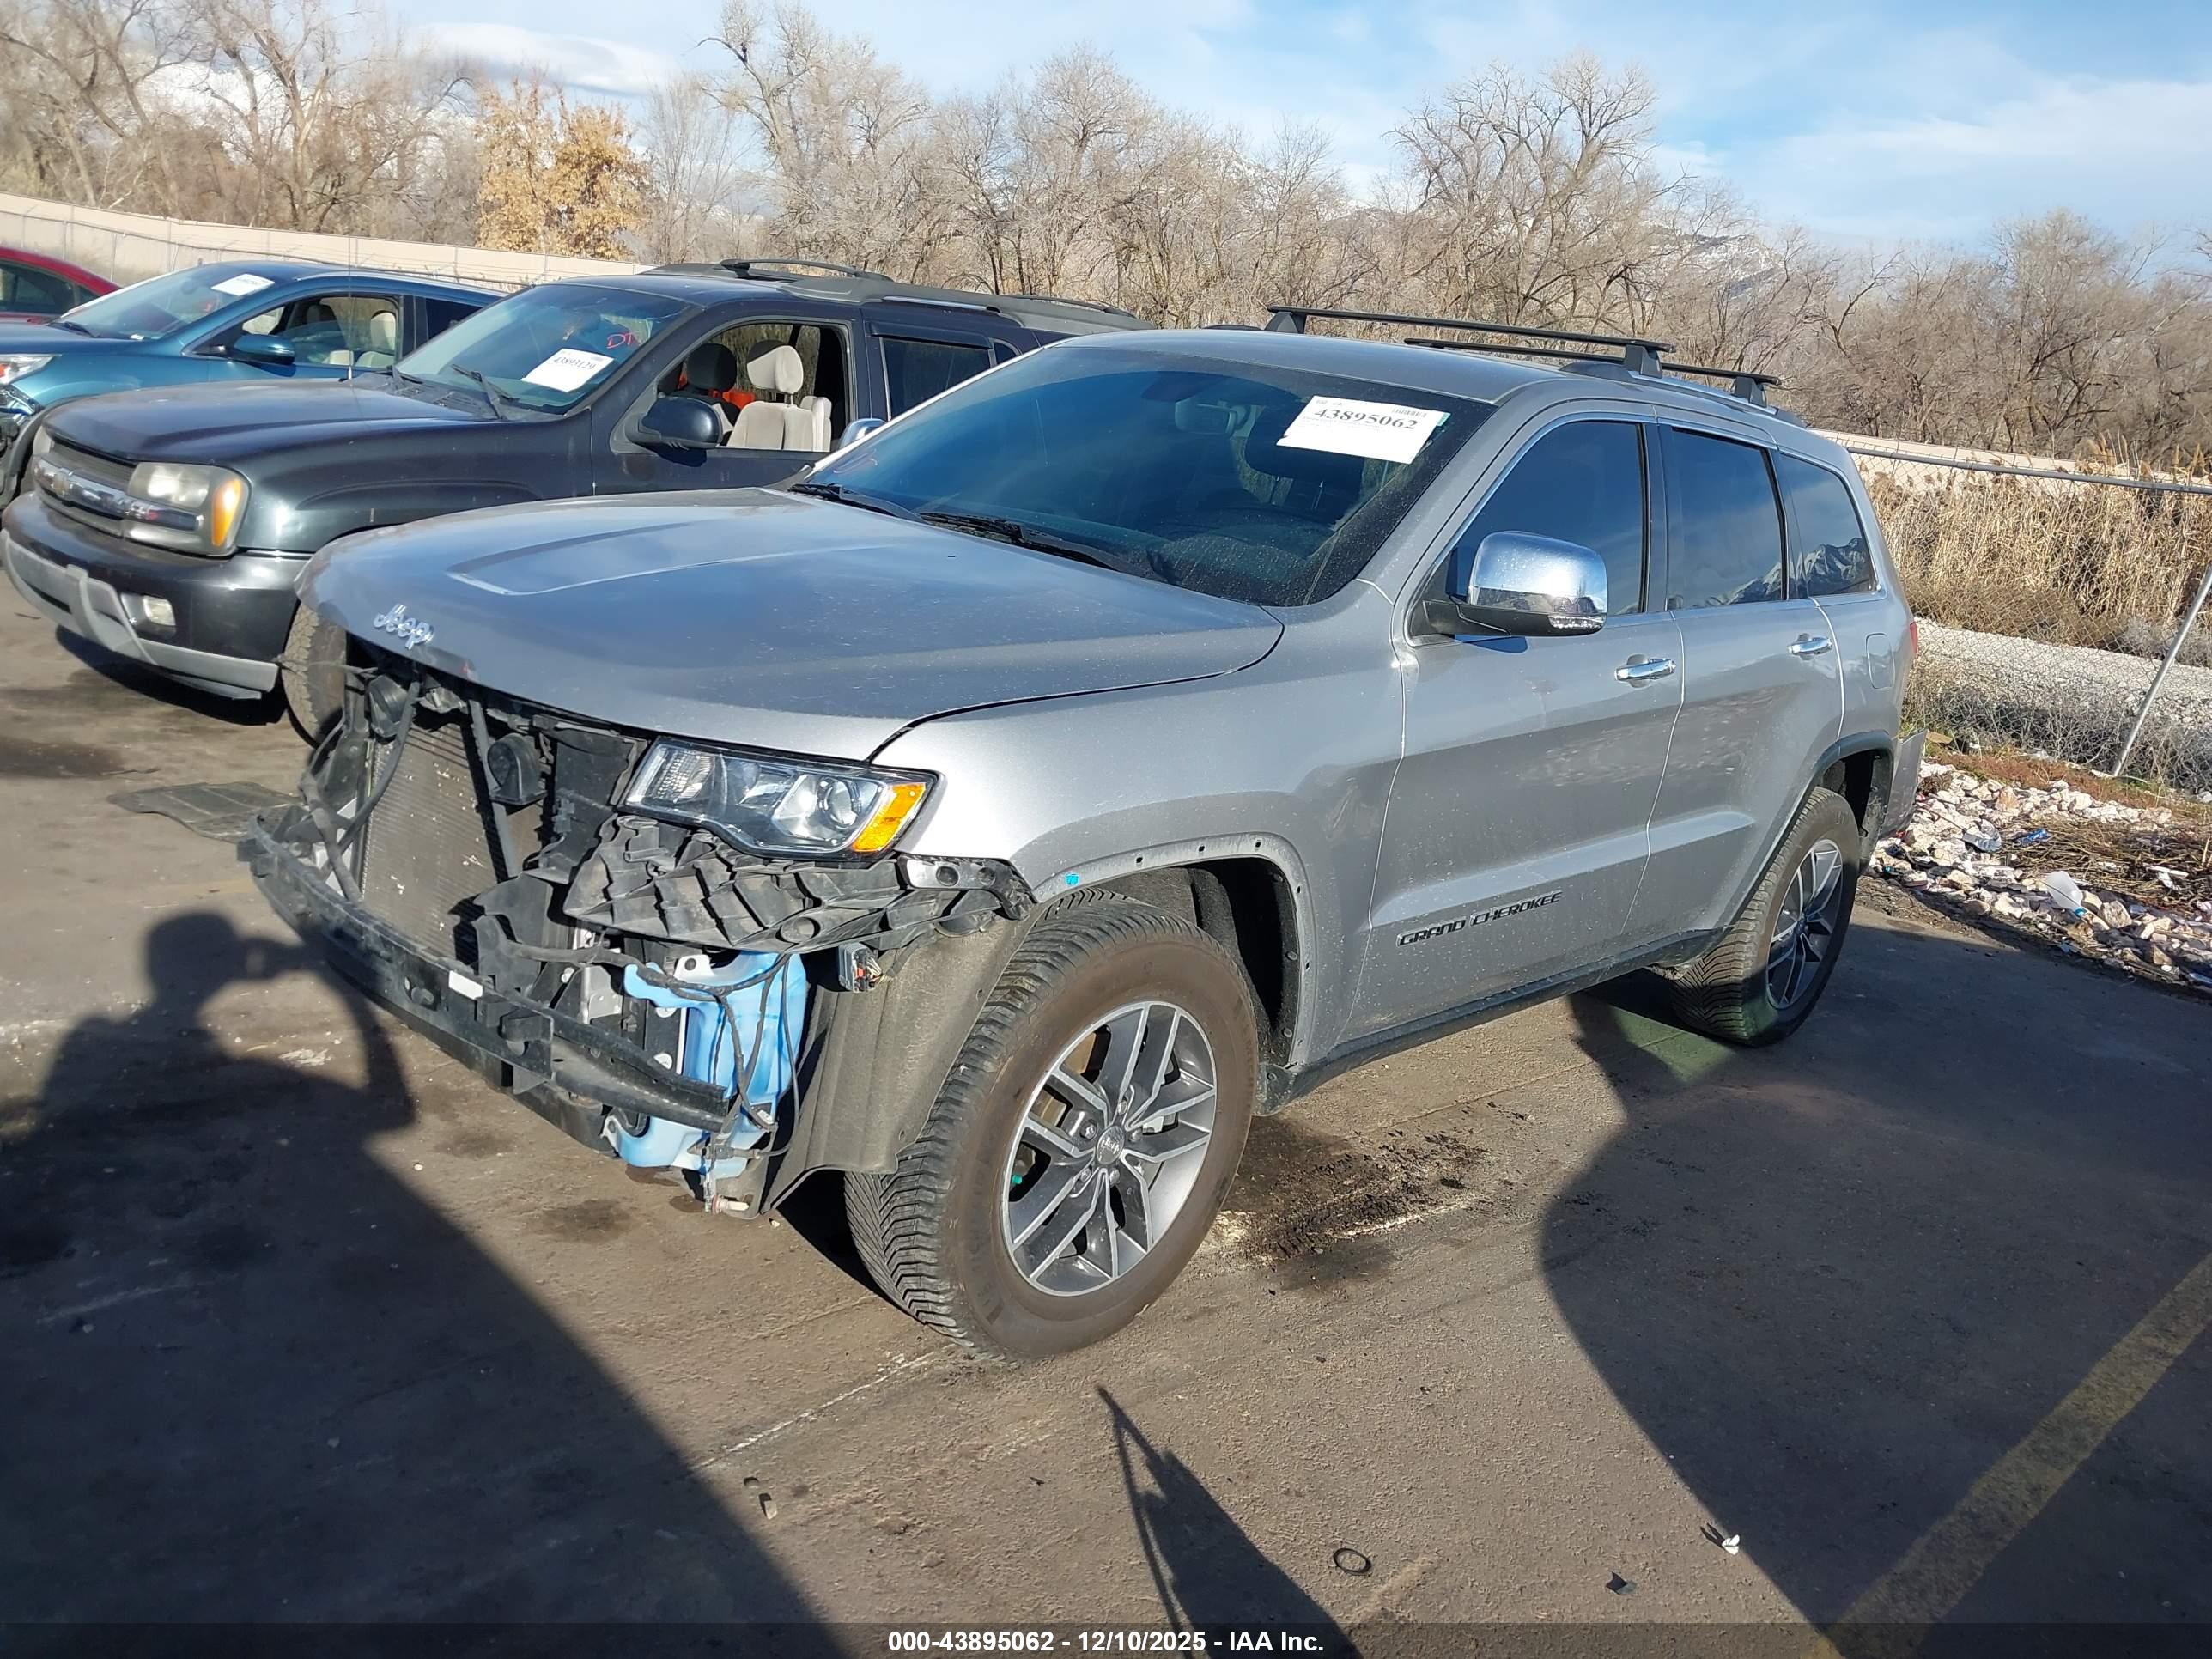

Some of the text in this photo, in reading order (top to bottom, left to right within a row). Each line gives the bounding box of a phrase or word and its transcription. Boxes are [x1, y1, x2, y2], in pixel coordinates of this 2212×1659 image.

[1313, 408, 1419, 429] 43895062
[373, 604, 434, 650] Jeep
[1396, 890, 1564, 947] GRAND CHEROKEE
